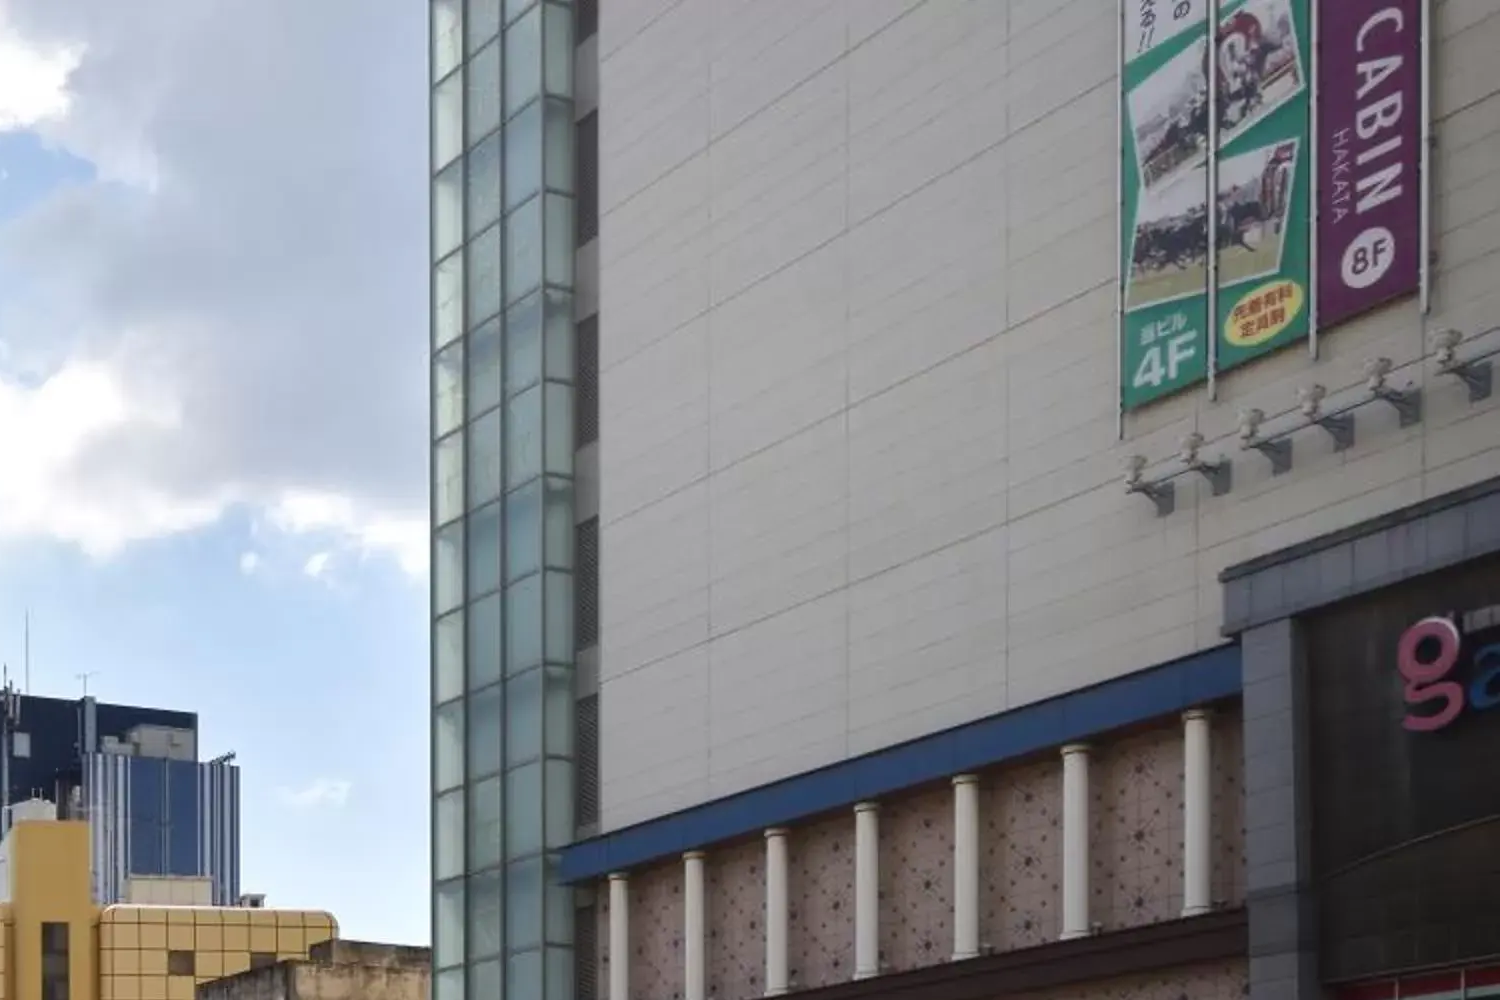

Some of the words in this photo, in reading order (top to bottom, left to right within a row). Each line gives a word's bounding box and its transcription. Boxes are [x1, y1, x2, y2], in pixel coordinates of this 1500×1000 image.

[1356, 7, 1404, 214] CABIN
[1332, 127, 1350, 224] HAKATA
[1351, 239, 1388, 275] 8F
[1133, 328, 1198, 388] 4F
